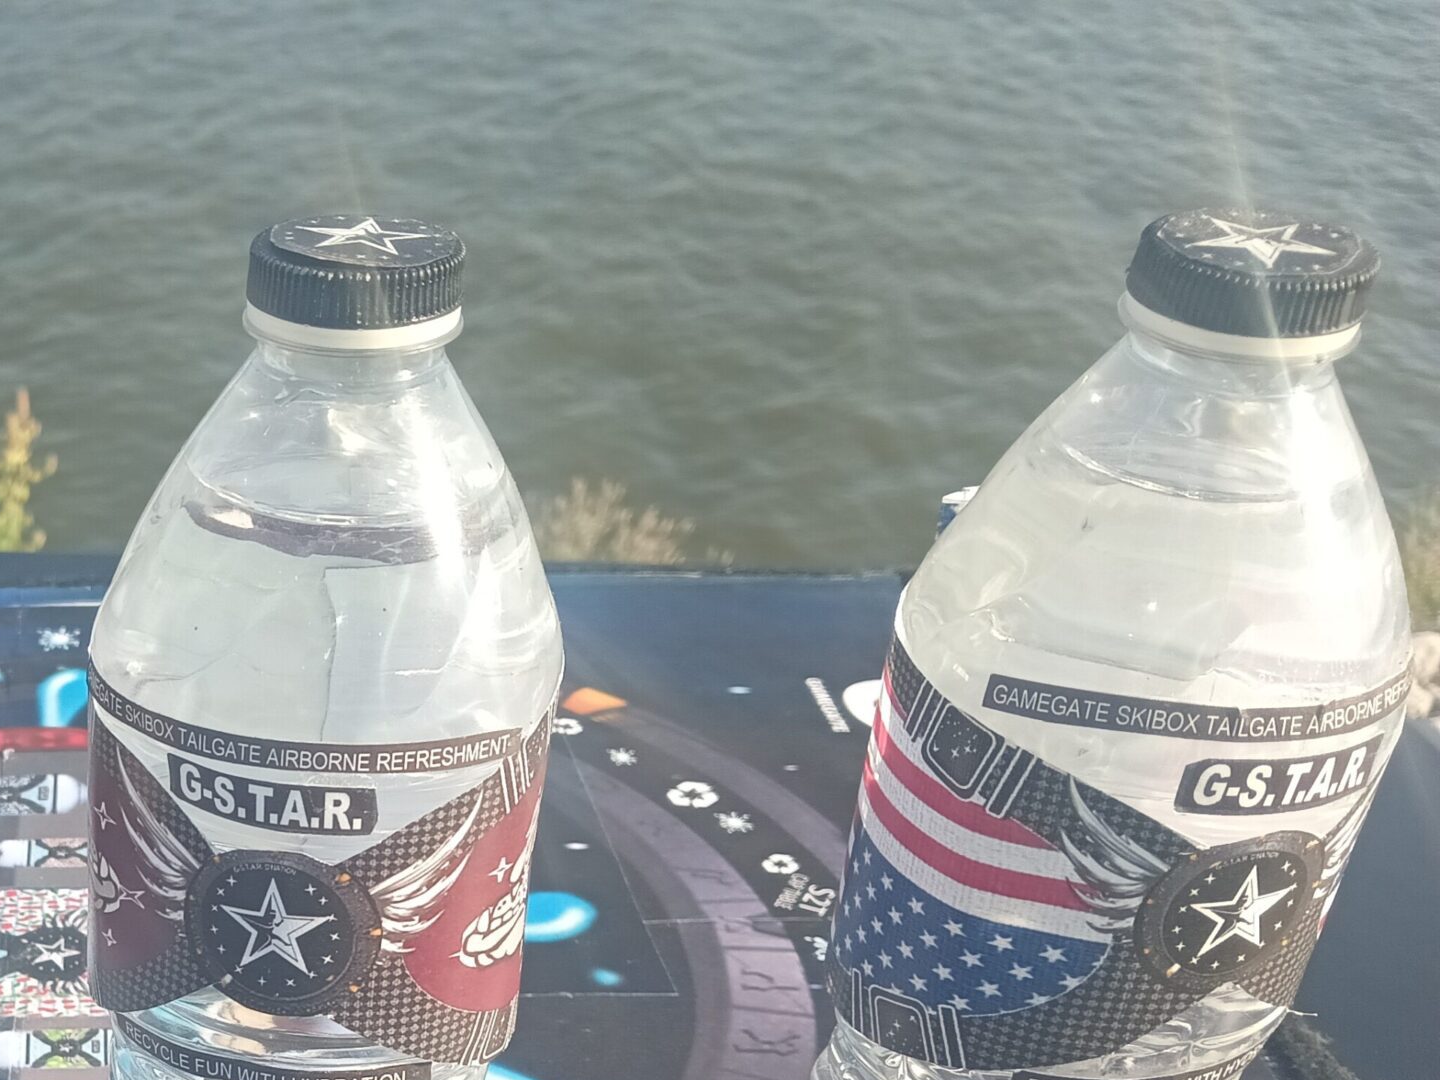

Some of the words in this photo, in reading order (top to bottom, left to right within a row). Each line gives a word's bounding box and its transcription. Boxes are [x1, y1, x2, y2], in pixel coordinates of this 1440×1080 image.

[125, 704, 175, 742] SKIBOX
[177, 727, 261, 763] TAILGATE
[266, 748, 370, 771] AIRBORNE
[376, 734, 510, 771] REFRESHMENT
[993, 684, 1110, 723] GAMEGATE
[1115, 705, 1200, 734] SKIBOX
[1207, 715, 1303, 737] TAILGATE
[1306, 693, 1384, 734] AIRBORNE
[179, 763, 362, 830] G-S.T.A.R.
[1193, 746, 1367, 808] G-S.T.A.R.
[125, 1022, 190, 1070] RECYCLE
[194, 1058, 232, 1080] FUN
